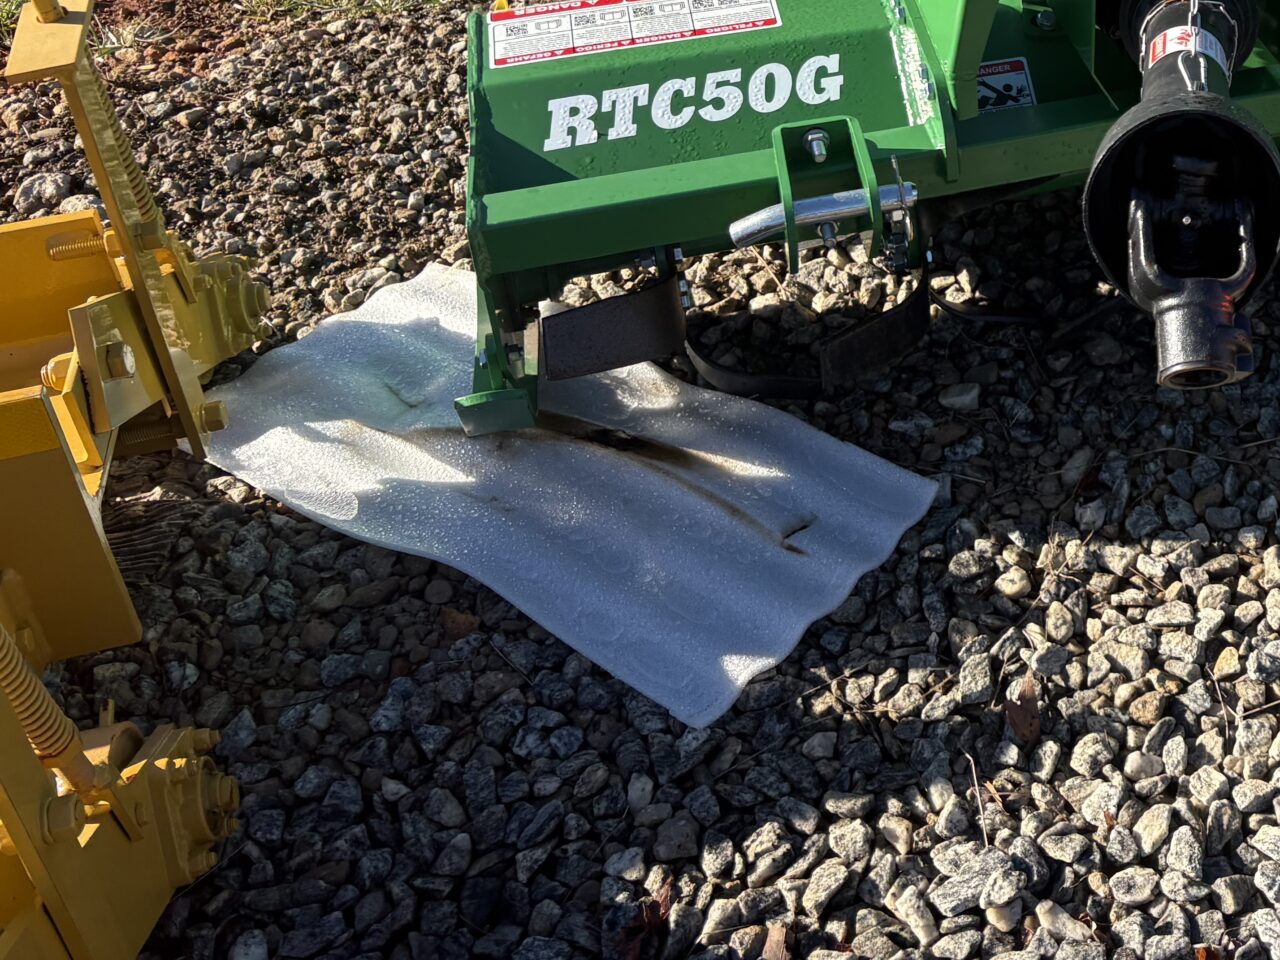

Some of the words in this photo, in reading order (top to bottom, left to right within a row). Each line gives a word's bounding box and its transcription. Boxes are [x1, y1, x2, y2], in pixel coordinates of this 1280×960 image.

[514, 1, 581, 15] DANGER
[635, 33, 681, 43] DANGER
[506, 51, 551, 63] GEFAHR
[977, 64, 1011, 76] ANGER
[543, 53, 844, 152] RTC50G
